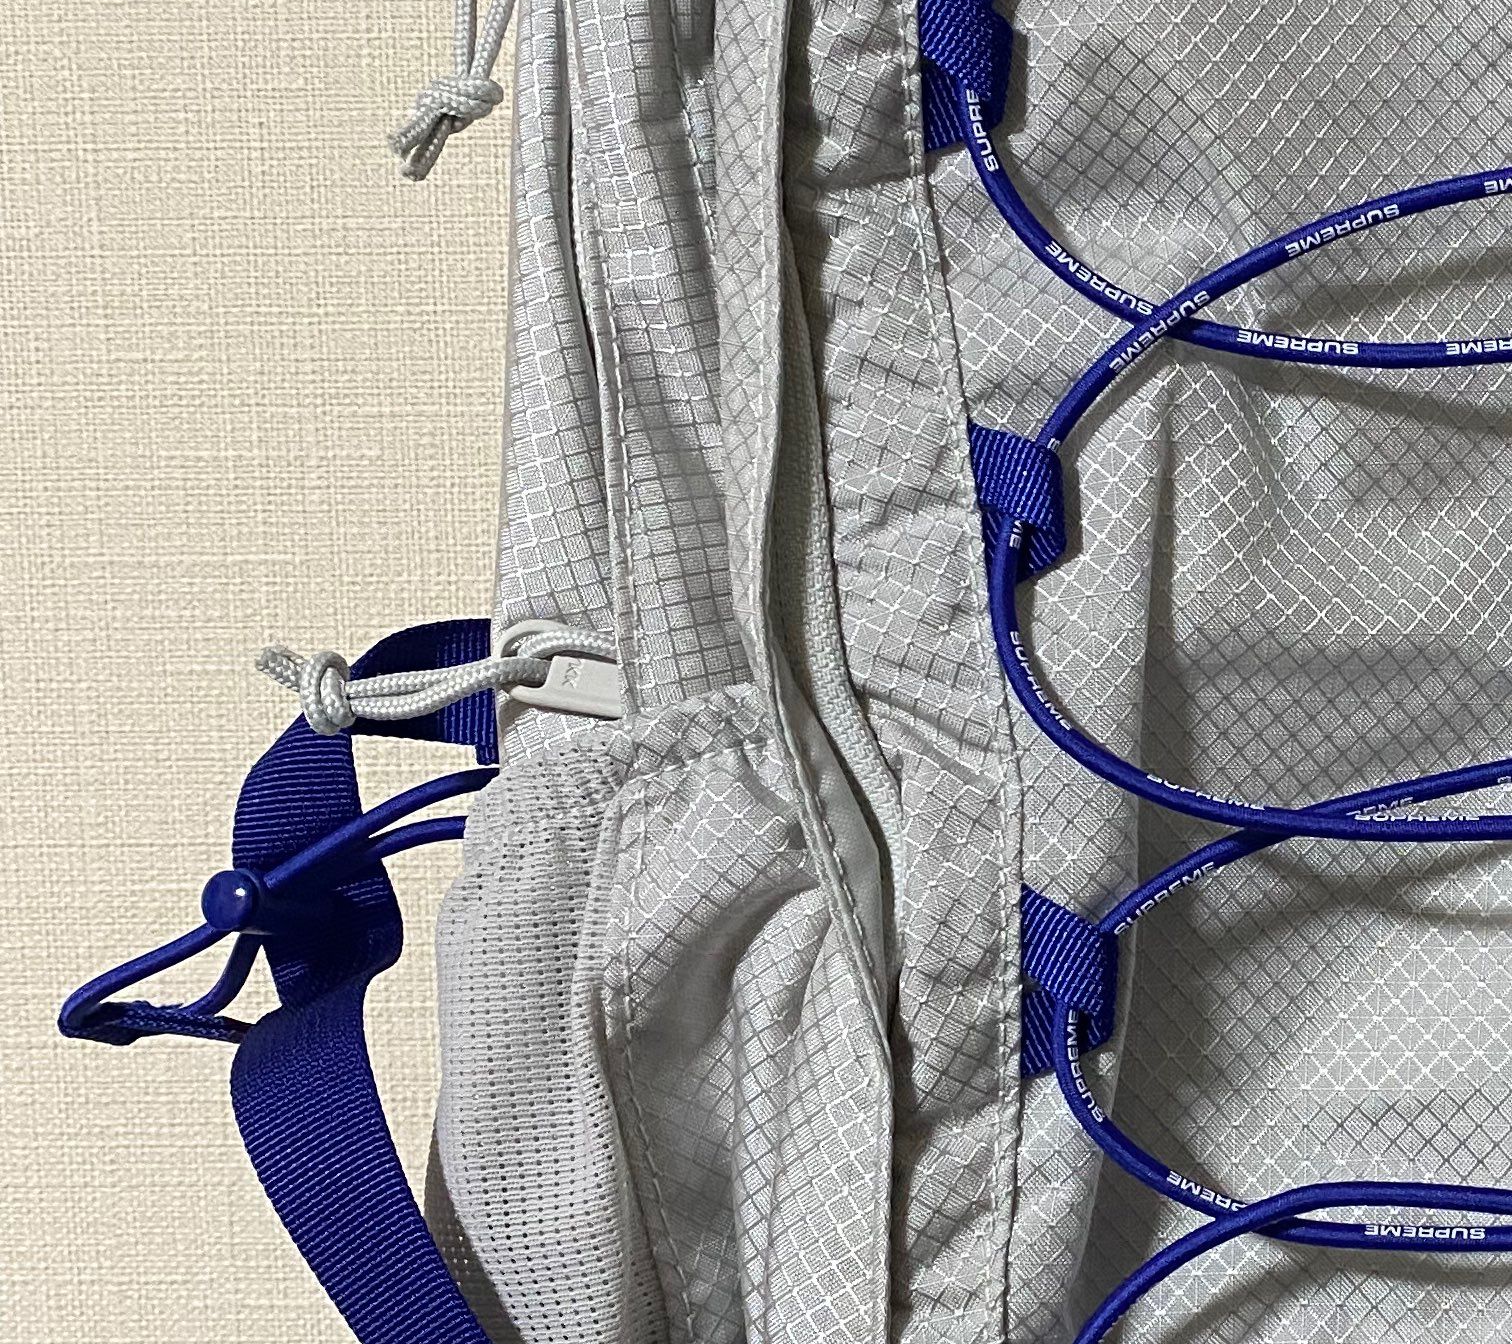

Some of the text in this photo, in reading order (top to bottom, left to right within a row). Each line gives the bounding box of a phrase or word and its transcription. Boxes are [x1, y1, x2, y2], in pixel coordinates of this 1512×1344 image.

[965, 88, 1000, 173] SUPRE
[1284, 203, 1400, 257] SUPREME
[1044, 240, 1154, 316] SUPREME
[1108, 290, 1211, 373] SUPREME
[1236, 328, 1359, 356] SUPREME
[1114, 860, 1219, 935] SUPREME
[1066, 1009, 1104, 1123] SUPREME
[1364, 1222, 1487, 1240] SUPREME
